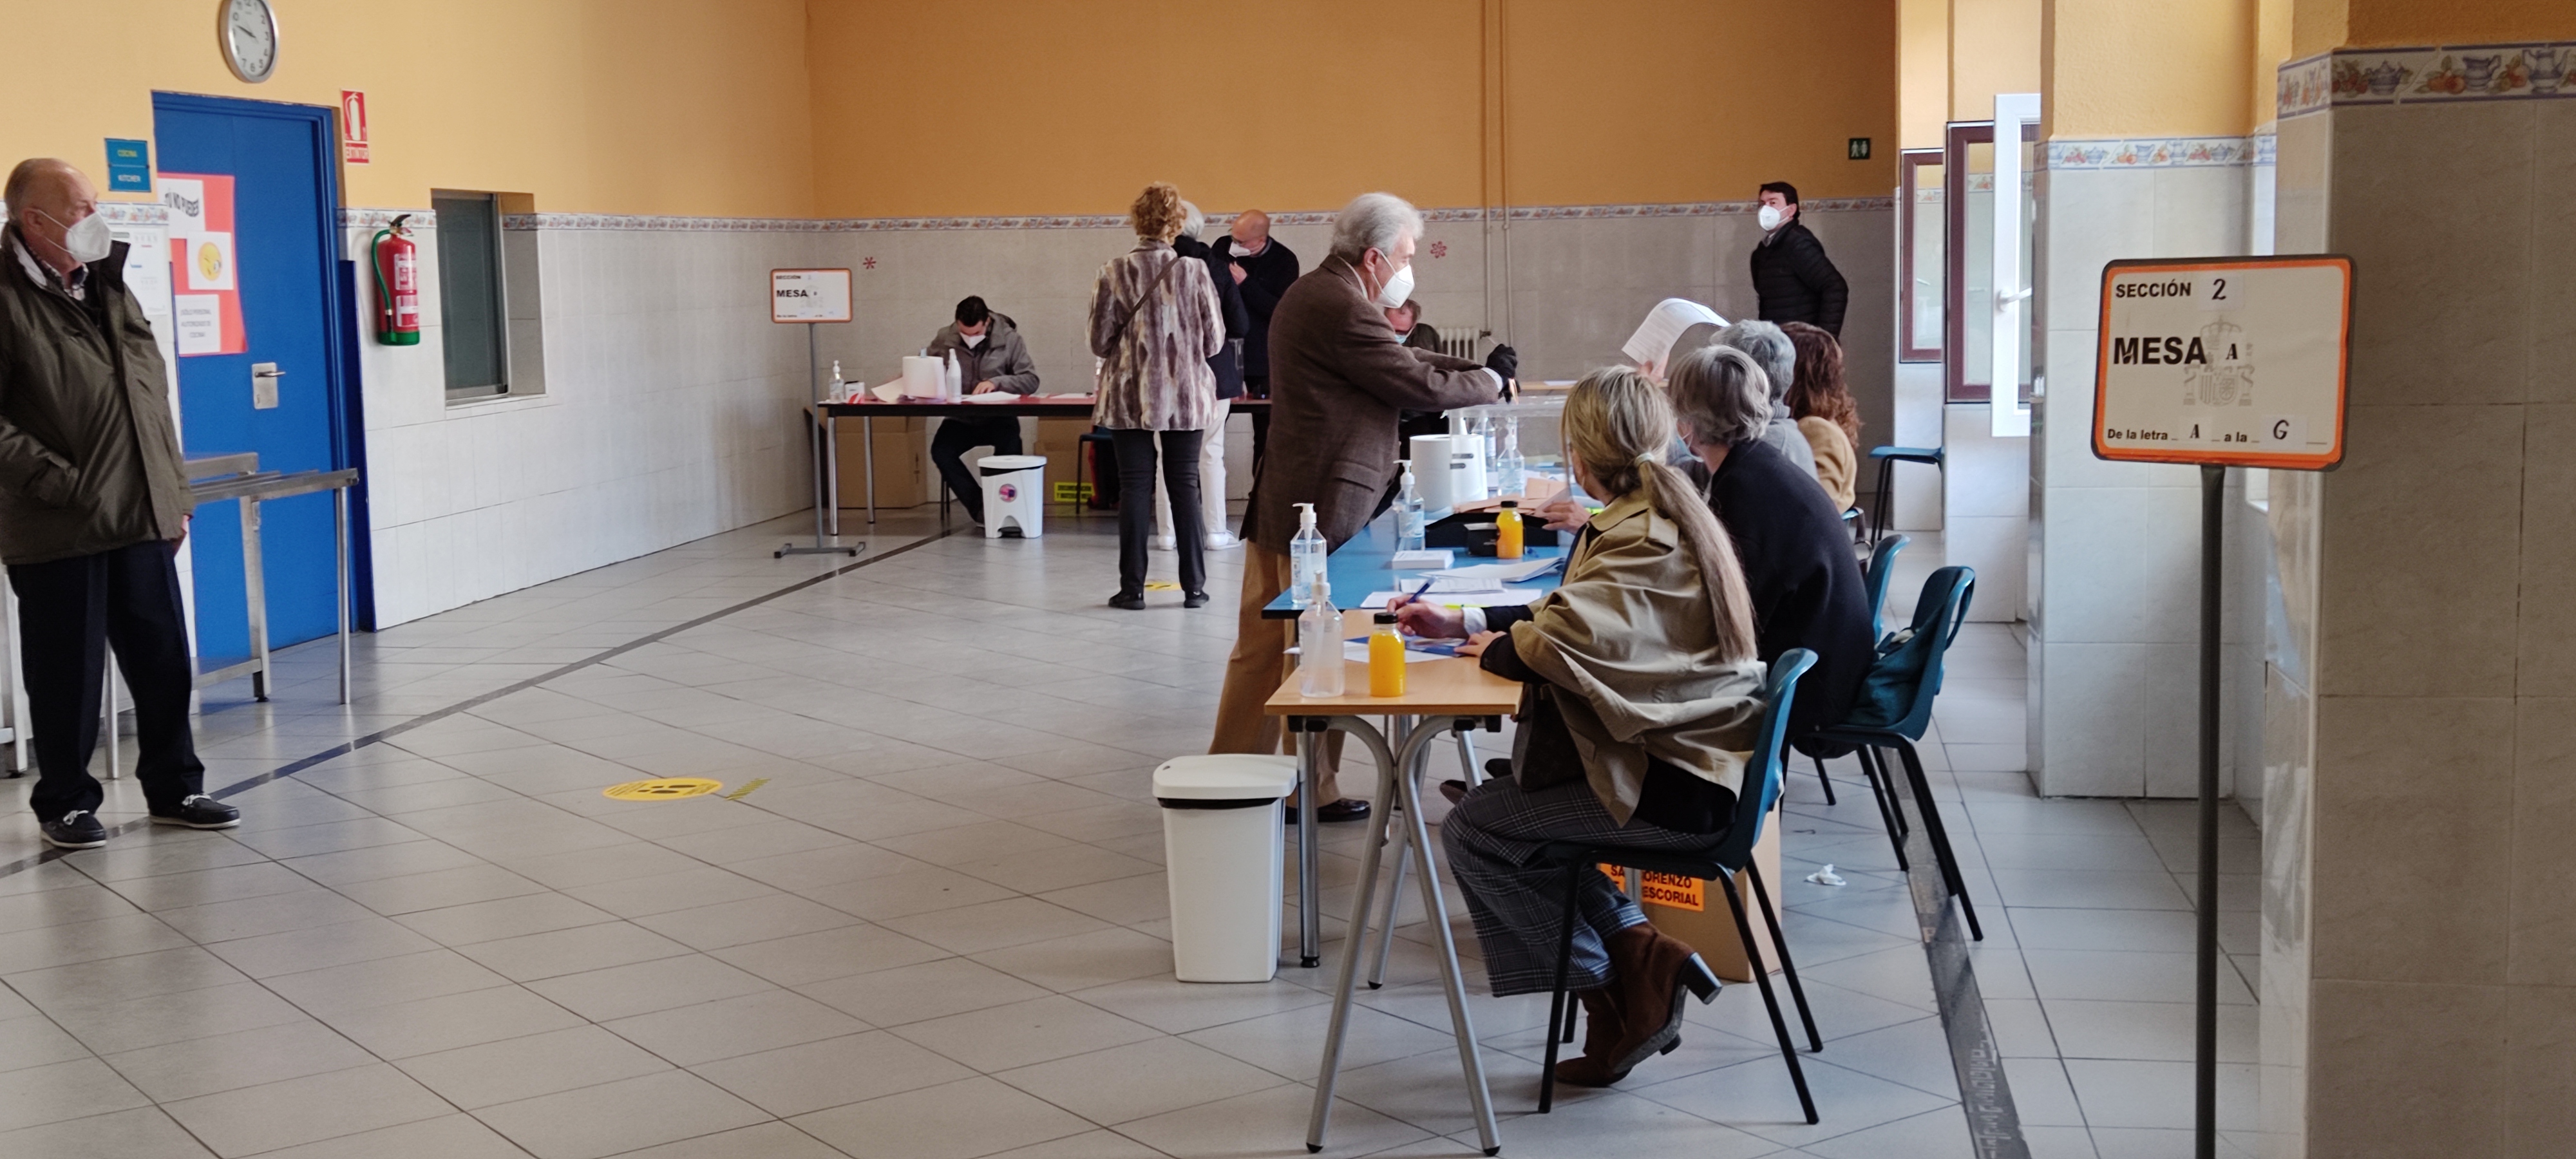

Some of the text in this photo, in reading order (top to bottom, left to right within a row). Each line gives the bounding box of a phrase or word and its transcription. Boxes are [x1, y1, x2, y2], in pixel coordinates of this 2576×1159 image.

[260, 14, 266, 25] 2
[2116, 278, 2227, 300] SECCIÓN 2
[2113, 336, 2238, 365] MESA A
[2107, 419, 2289, 443] De la letra A a la G
[1611, 865, 1692, 889] SA ORENZO
[1642, 886, 1698, 907] ESCORIAL
